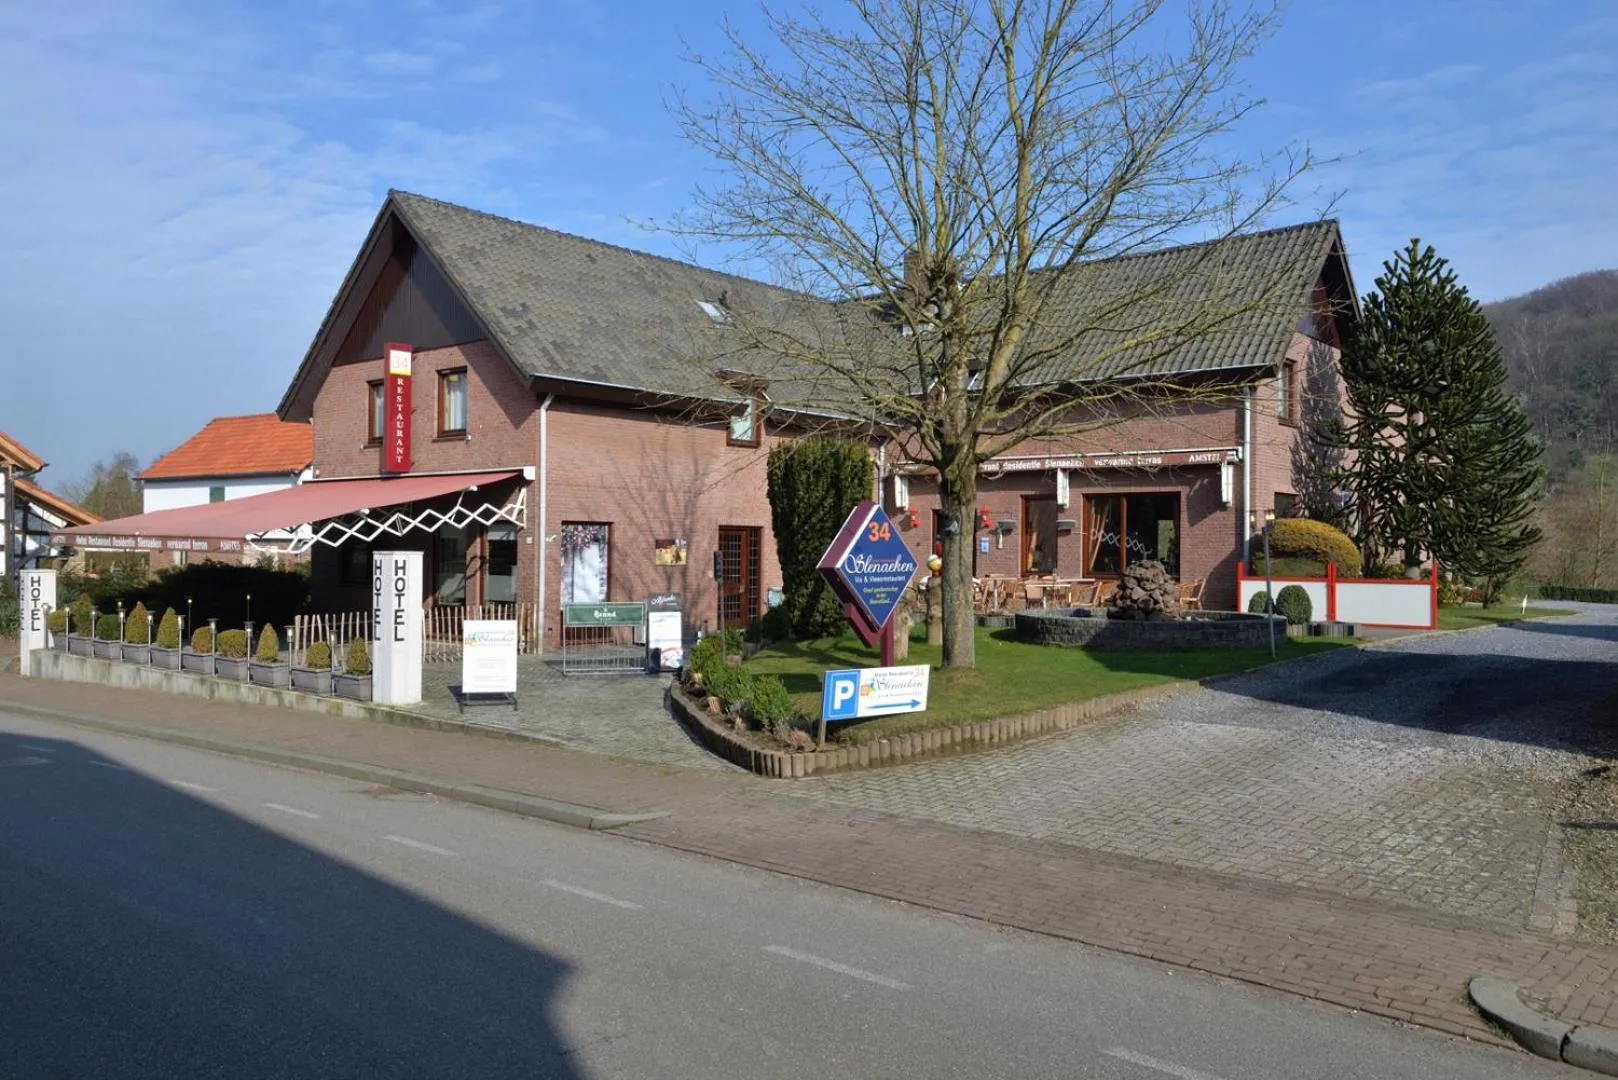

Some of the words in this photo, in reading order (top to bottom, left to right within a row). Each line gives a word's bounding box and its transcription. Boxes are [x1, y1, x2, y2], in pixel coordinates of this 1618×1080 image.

[396, 377, 405, 464] RESTAURANT
[1188, 453, 1221, 463] AMSTEL
[868, 521, 891, 542] 34
[844, 553, 915, 574] Slenaeken
[30, 575, 41, 632] HOTEL
[374, 559, 382, 642] HOTEL
[394, 559, 406, 642] HOTEL
[833, 680, 855, 710] P
